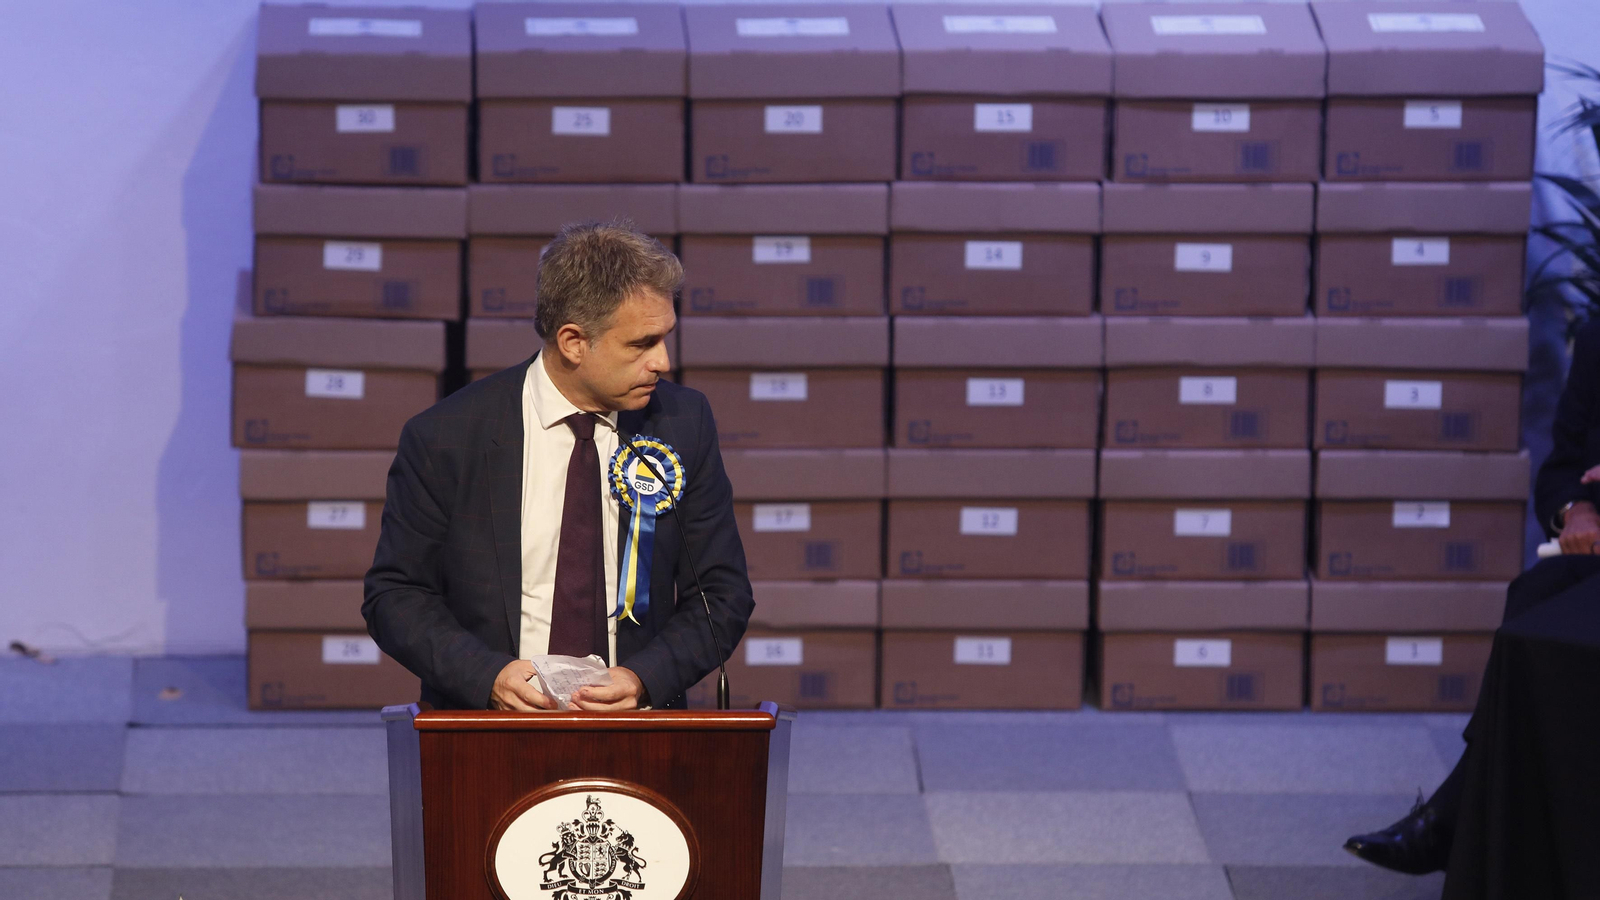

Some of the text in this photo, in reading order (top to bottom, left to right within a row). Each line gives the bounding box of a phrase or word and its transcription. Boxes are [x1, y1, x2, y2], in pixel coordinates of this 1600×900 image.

[573, 112, 593, 128] 25
[784, 111, 804, 127] 20
[997, 109, 1015, 125] 15
[1213, 109, 1232, 124] 10
[1429, 106, 1440, 122] 5
[345, 247, 365, 263] 29
[1201, 250, 1211, 265] 9
[326, 375, 345, 390] 28
[989, 383, 1007, 399] 13
[634, 481, 654, 492] GSD
[329, 506, 348, 522] 27
[775, 509, 794, 525] 17
[1415, 504, 1425, 521] 2
[982, 513, 1000, 529] 12
[1200, 513, 1210, 529] 7
[342, 641, 361, 656] 26
[977, 643, 994, 659] 11
[621, 881, 640, 889] DROIT
